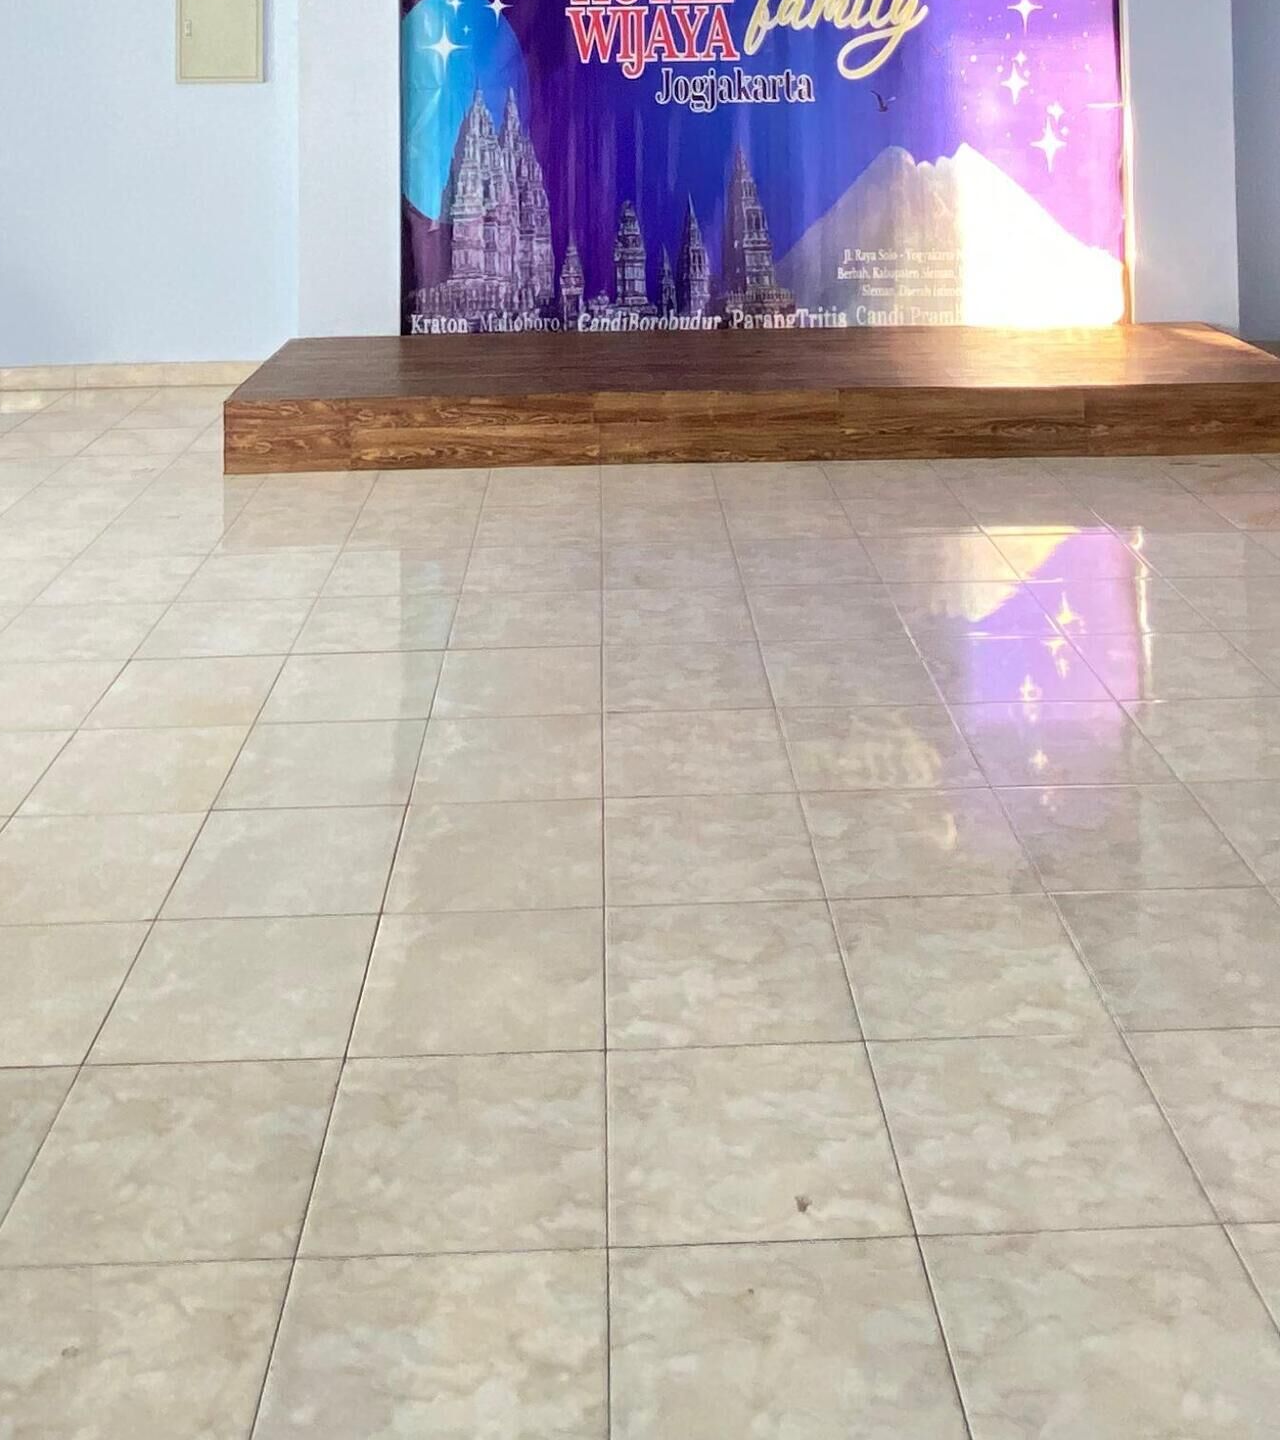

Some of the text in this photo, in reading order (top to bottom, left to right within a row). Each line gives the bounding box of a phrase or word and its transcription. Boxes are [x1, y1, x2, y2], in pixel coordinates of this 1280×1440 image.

[565, 5, 740, 79] WIJAYA
[655, 67, 814, 113] Jogjakarta
[855, 248, 876, 263] Raya
[410, 314, 469, 334] Kraton
[856, 304, 905, 326] Candi
